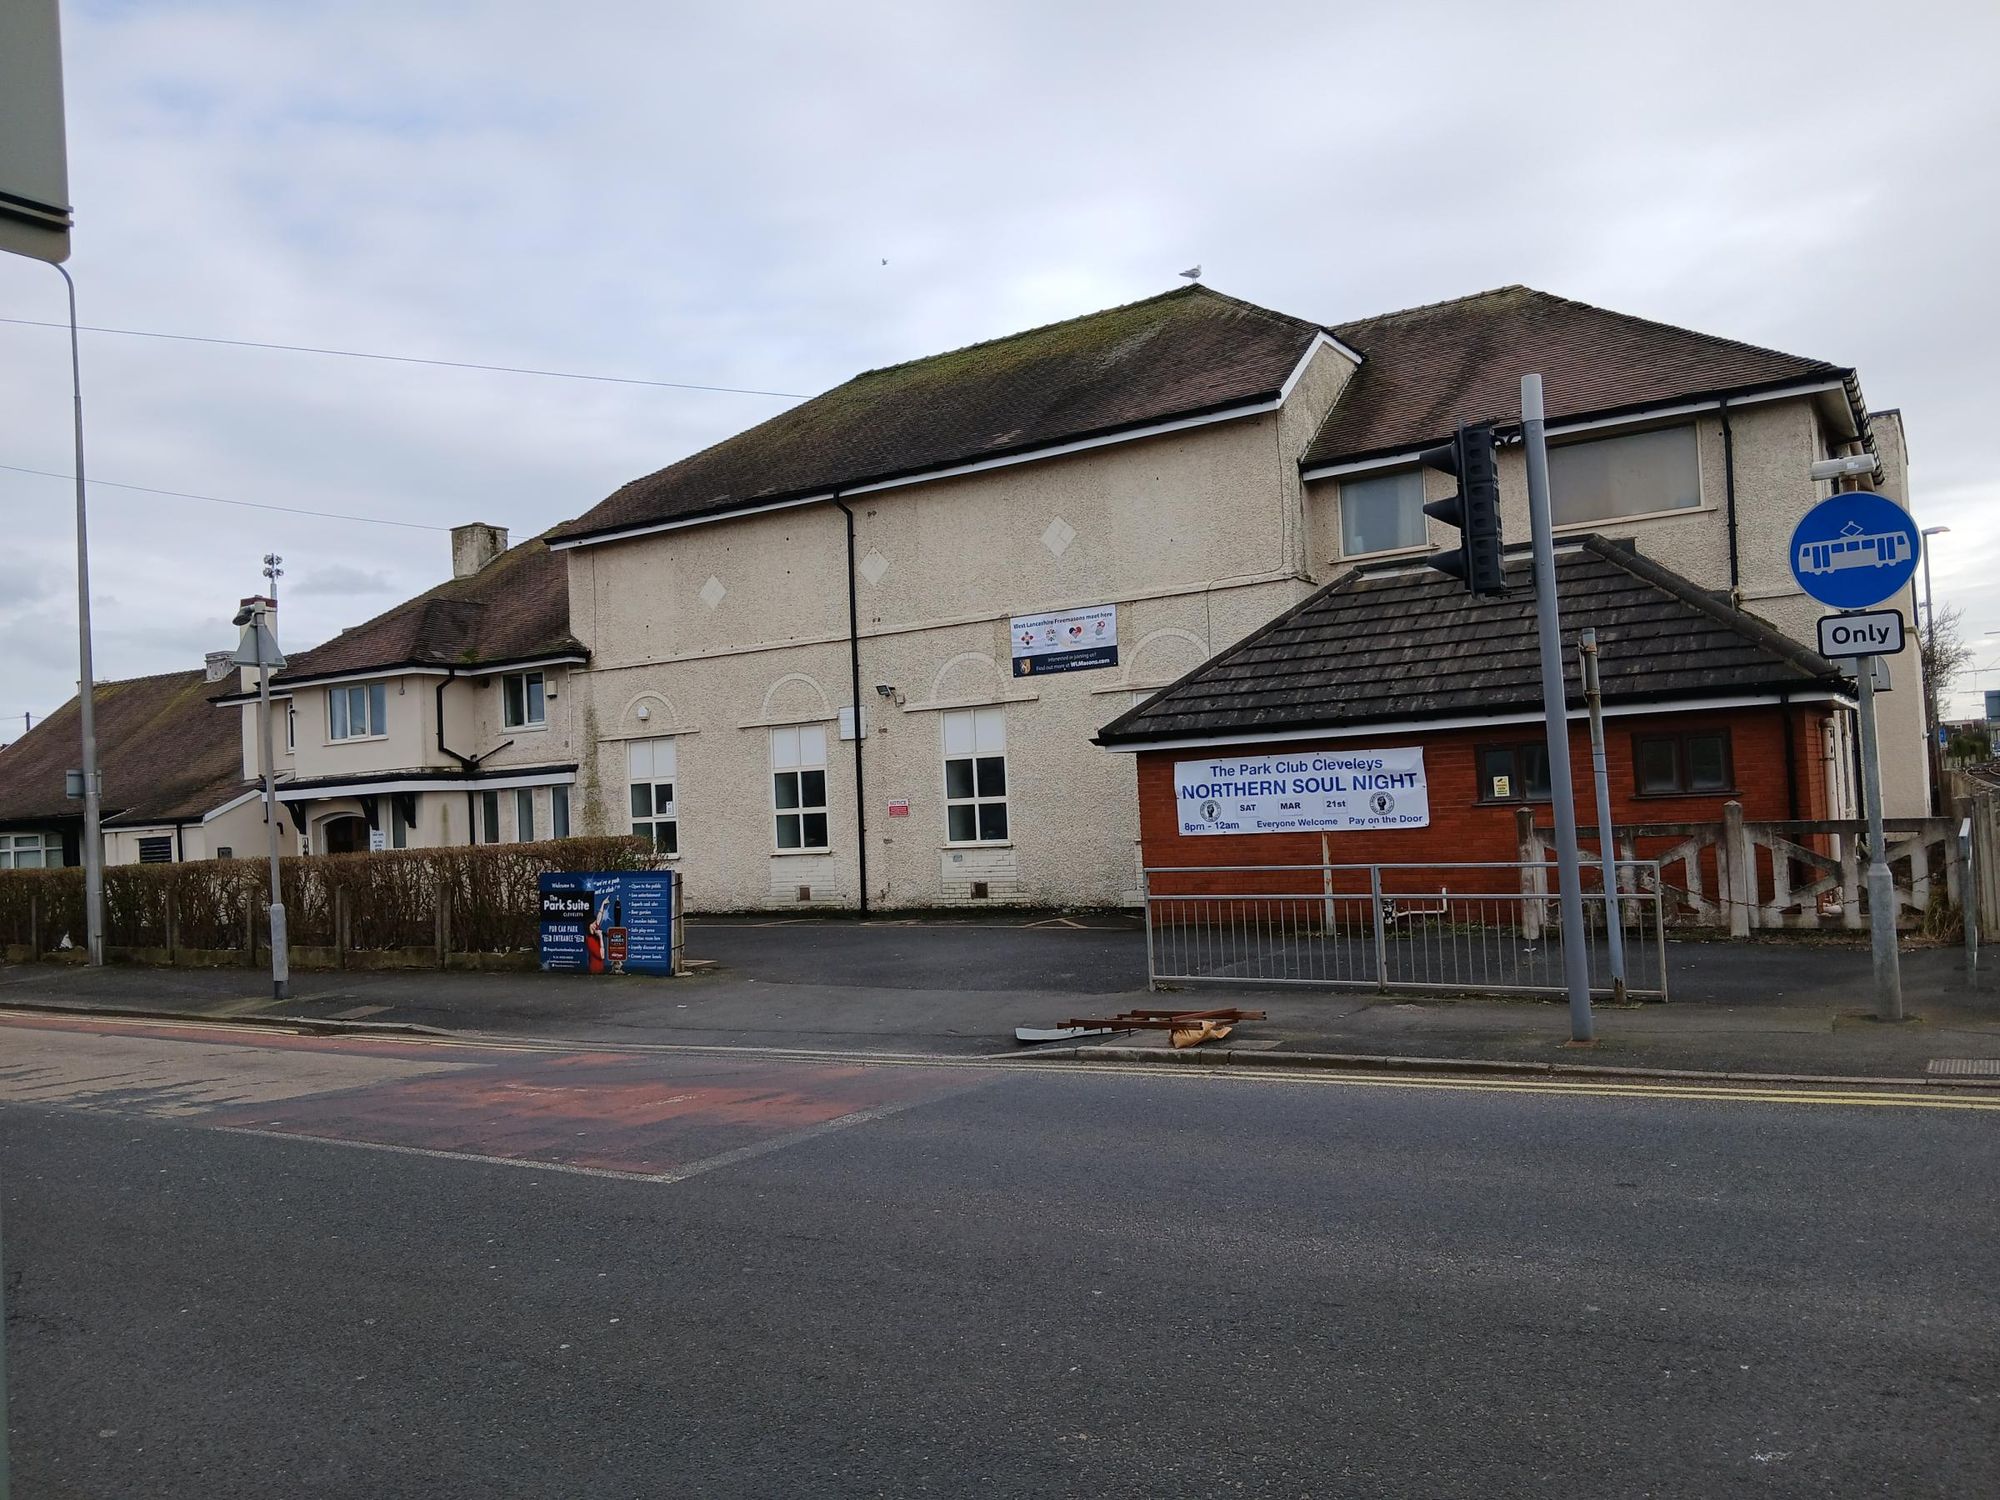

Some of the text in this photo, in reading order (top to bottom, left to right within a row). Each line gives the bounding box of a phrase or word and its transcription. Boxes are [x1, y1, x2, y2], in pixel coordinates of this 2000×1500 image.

[1026, 619, 1054, 628] Lancashire
[1054, 616, 1085, 624] Freemasons
[1832, 624, 1890, 645] Only
[1070, 658, 1110, 668] WLMasons.com
[1210, 758, 1383, 777] The Park Club Cleveleys
[1182, 772, 1417, 799] NORTHERN SOUL NIGHT
[1240, 800, 1346, 812] SAT MAR 21st
[1184, 823, 1205, 832] 8pm
[1215, 821, 1240, 830] 12am
[1256, 820, 1296, 829] Everyone
[1297, 818, 1338, 826] Welcome
[1348, 816, 1365, 826] Pay
[1368, 816, 1380, 824] on
[1381, 816, 1397, 824] the
[1400, 814, 1423, 823] Door
[544, 899, 590, 910] Park Suite
